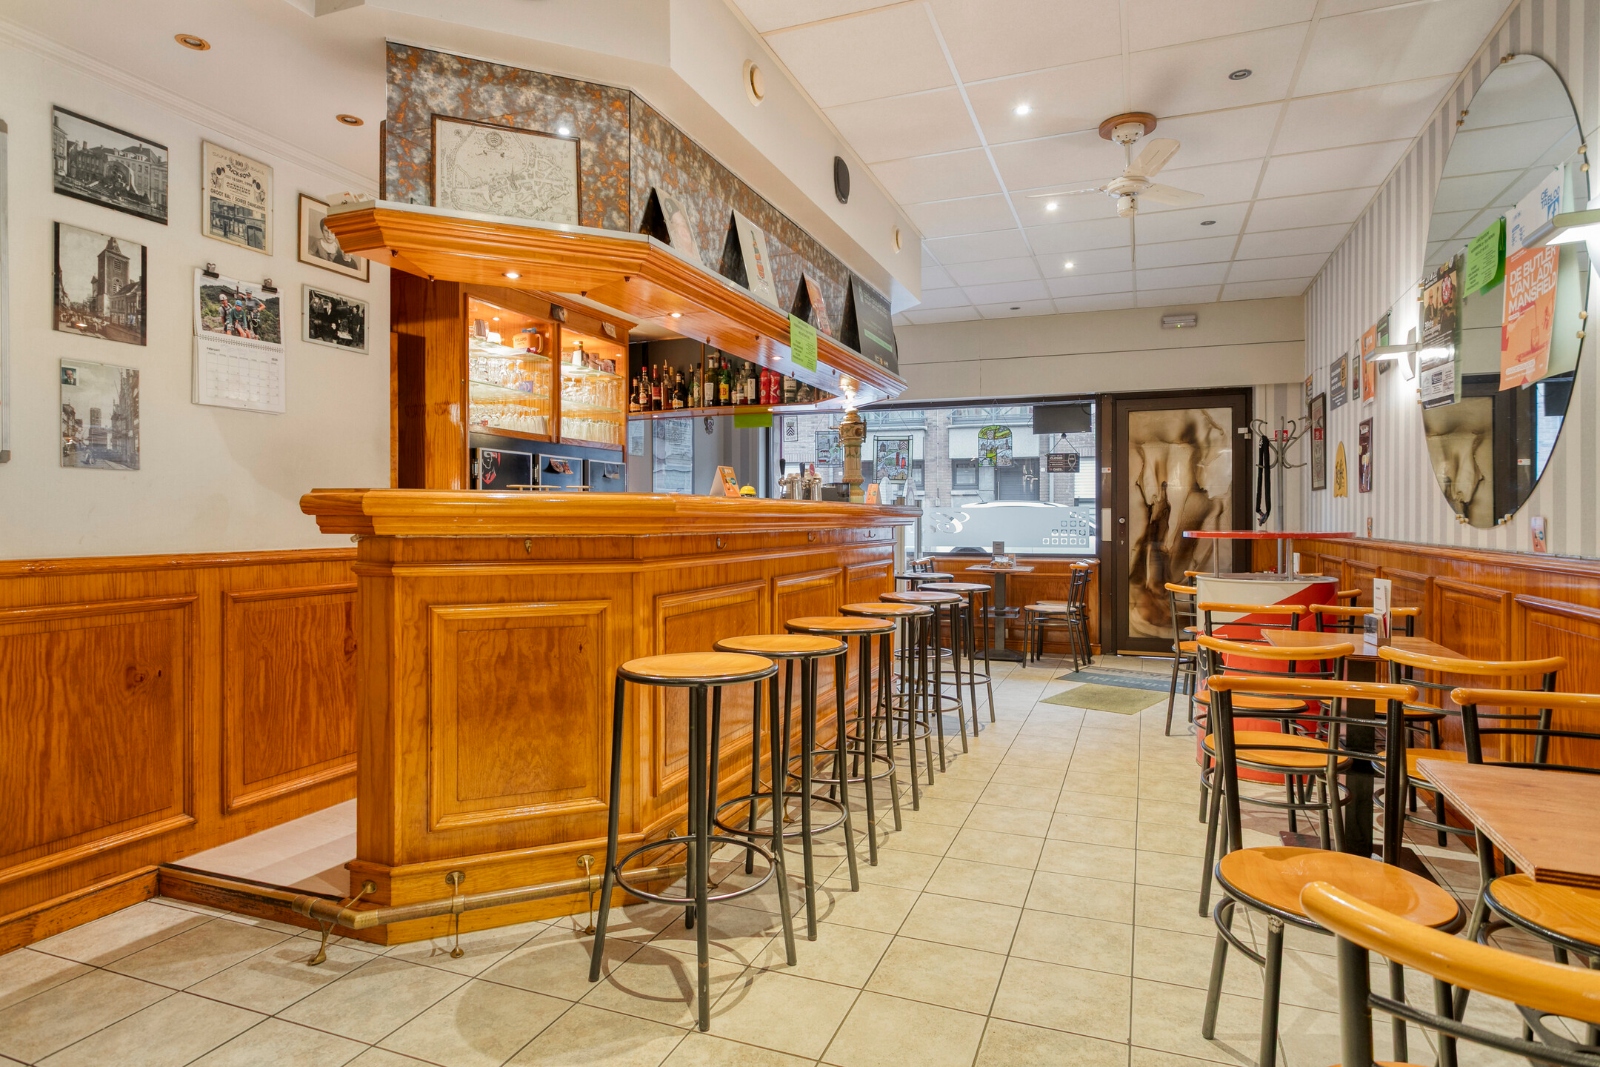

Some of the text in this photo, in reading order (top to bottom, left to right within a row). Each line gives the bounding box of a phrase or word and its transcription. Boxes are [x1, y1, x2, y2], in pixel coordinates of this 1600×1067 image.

[1541, 188, 1549, 200] DE
[1509, 265, 1522, 286] DE
[1523, 245, 1556, 277] BUTLER
[1509, 275, 1530, 299] VAN
[1531, 257, 1555, 287] LADY
[1508, 271, 1558, 314] MANSFIELD
